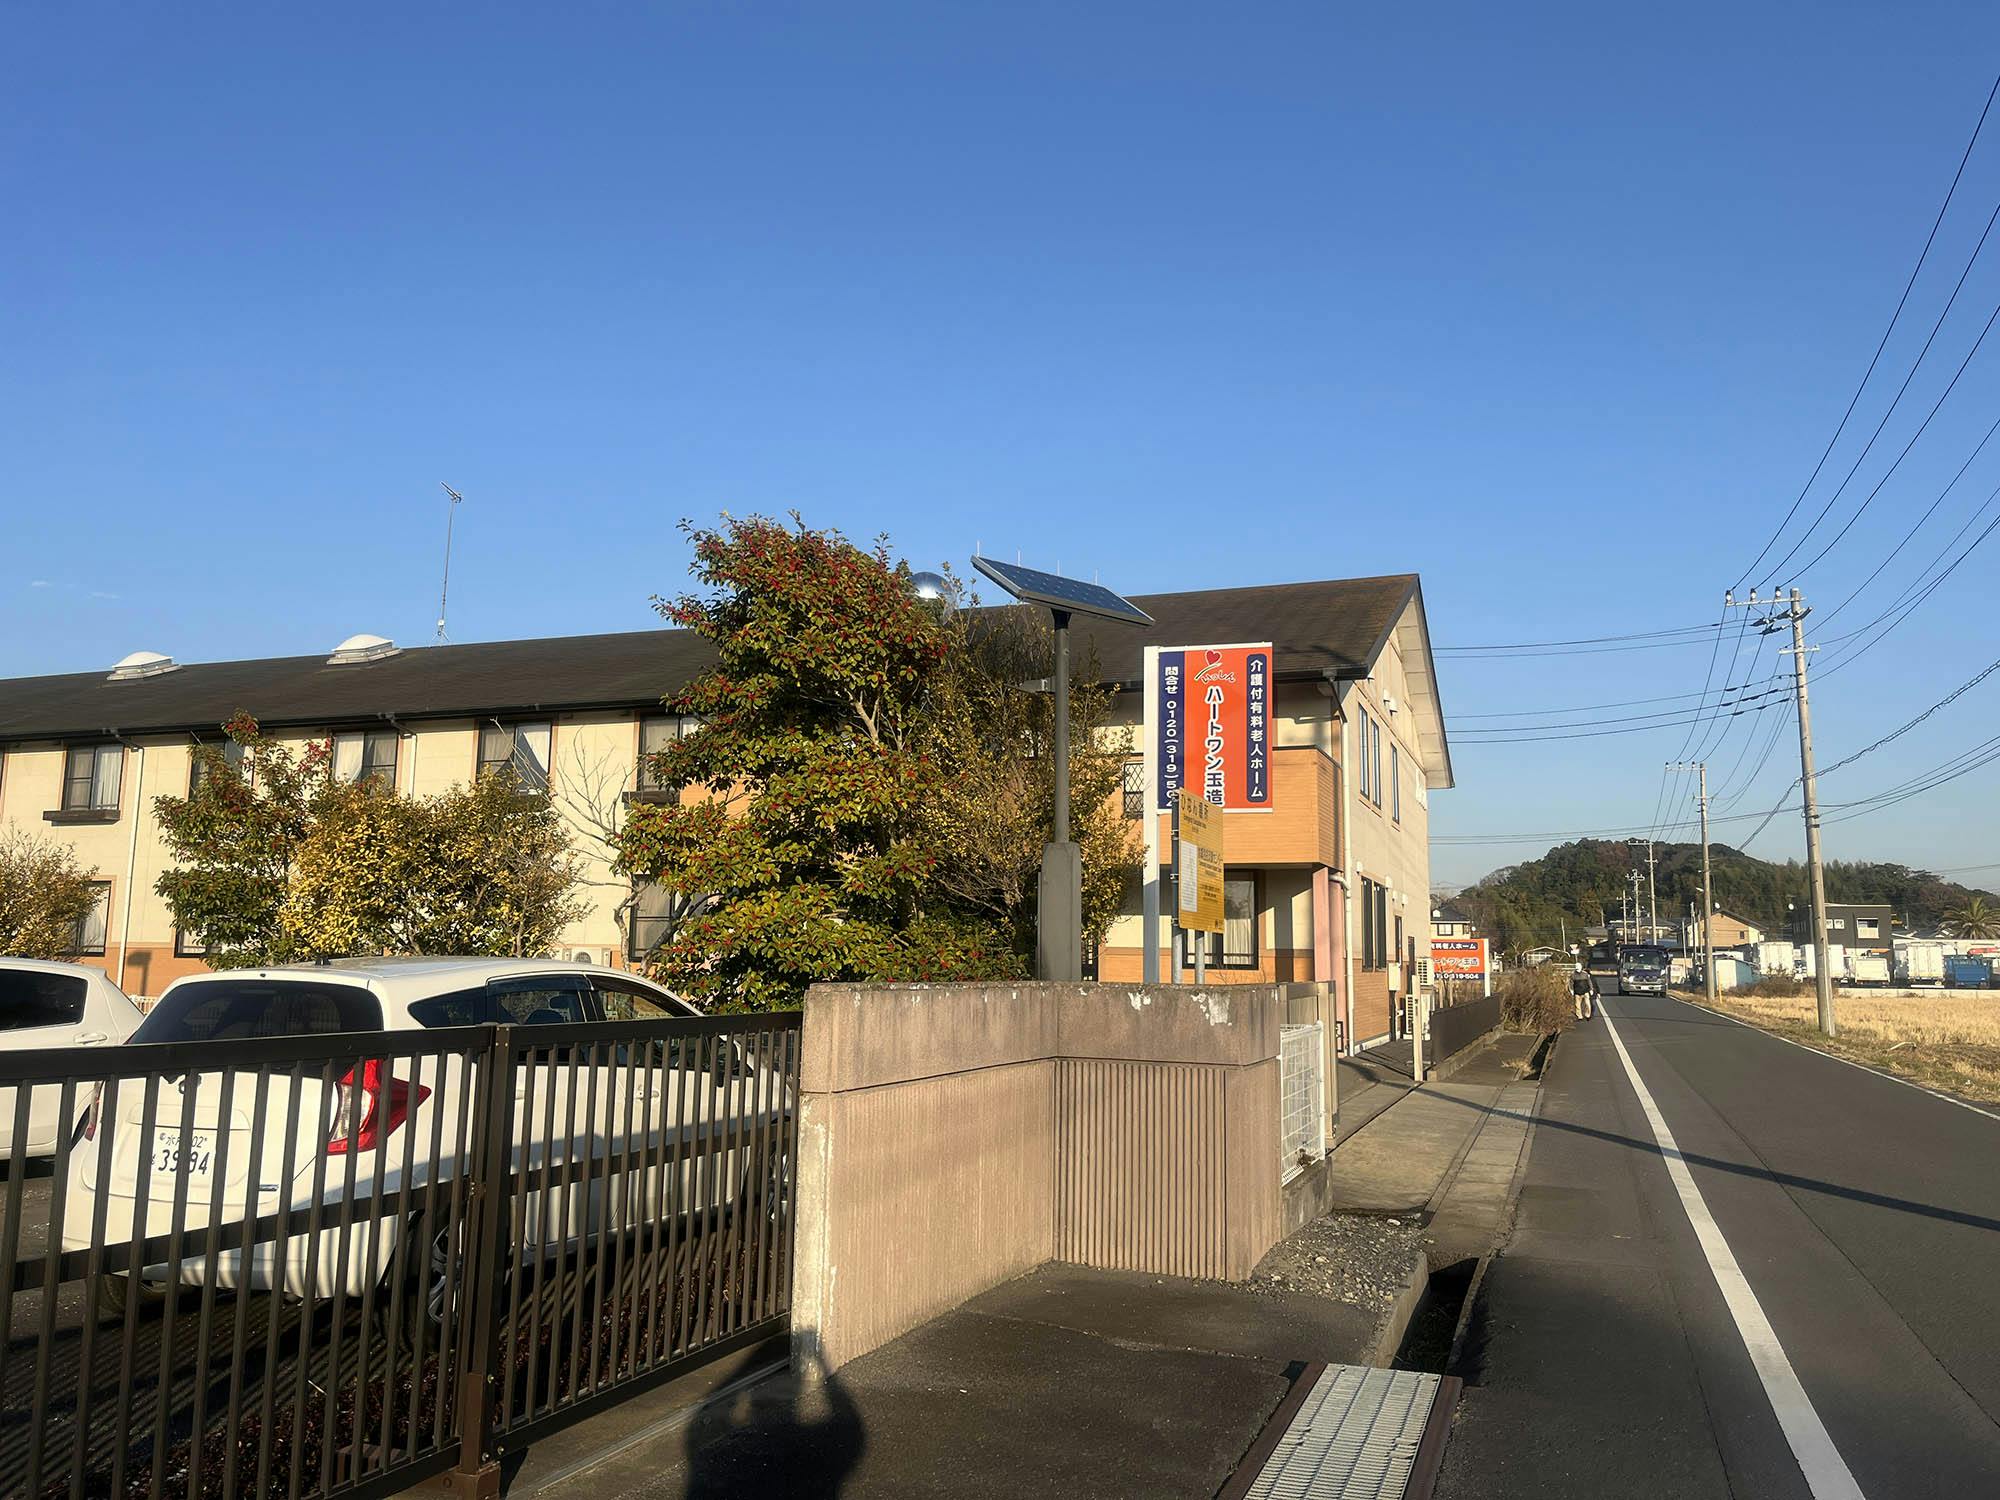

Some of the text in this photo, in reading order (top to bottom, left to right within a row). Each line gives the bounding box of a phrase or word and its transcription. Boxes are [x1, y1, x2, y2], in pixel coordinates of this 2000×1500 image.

[1164, 666, 1179, 695] 問合せ
[1201, 669, 1236, 684] いっしん
[1205, 686, 1225, 806] ハートワン玉造
[1250, 659, 1264, 798] 介護付有料老人ホーム
